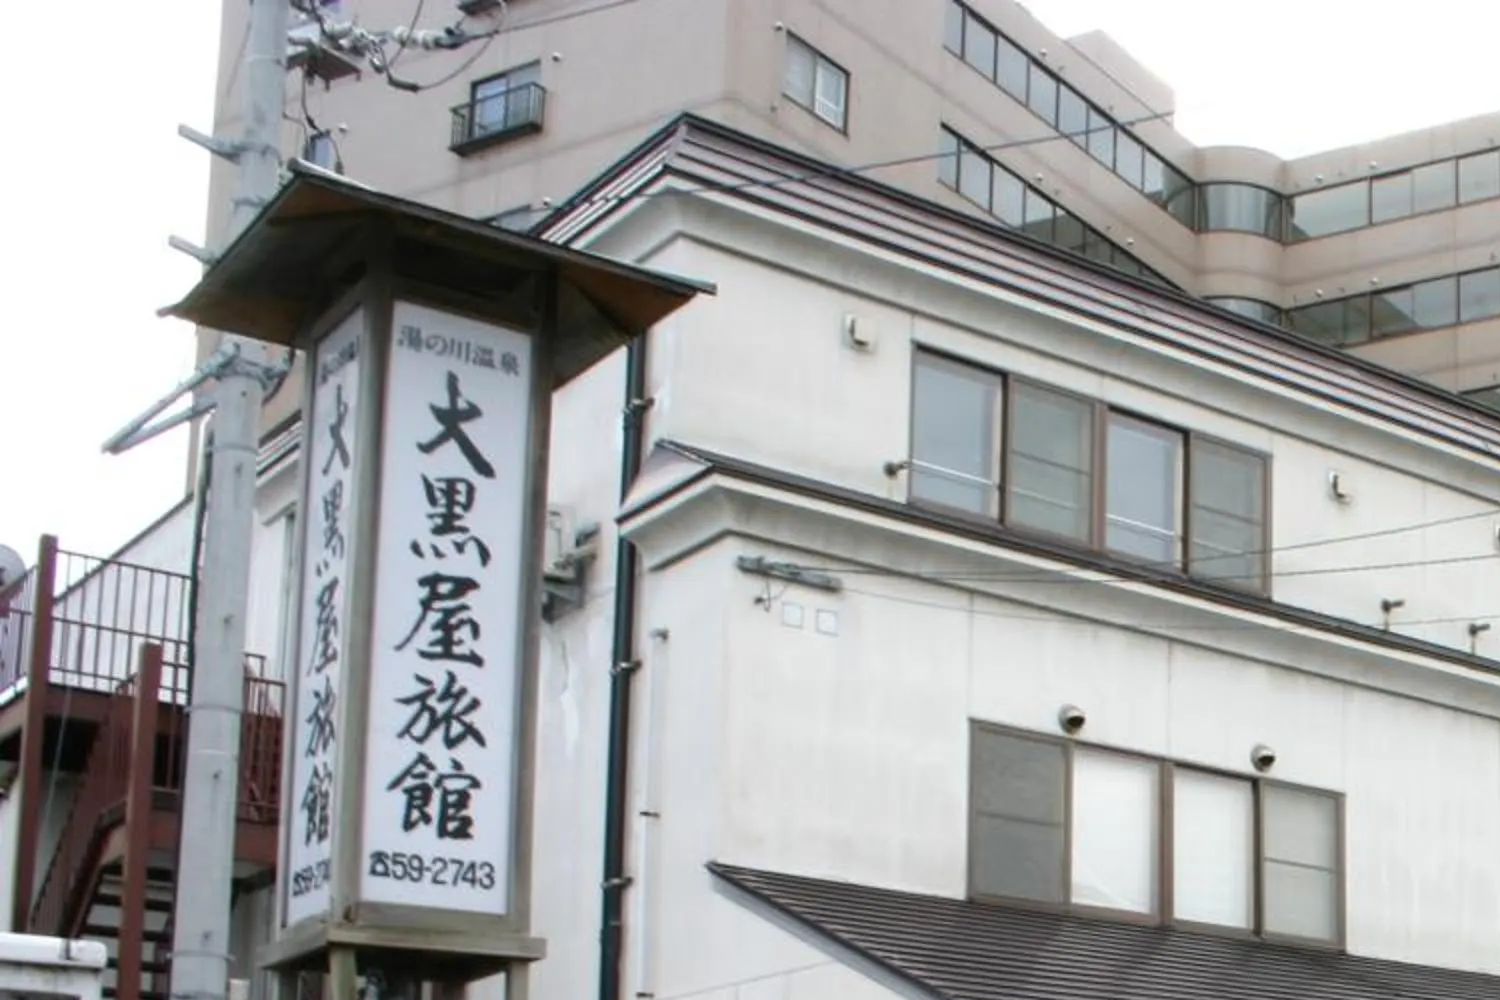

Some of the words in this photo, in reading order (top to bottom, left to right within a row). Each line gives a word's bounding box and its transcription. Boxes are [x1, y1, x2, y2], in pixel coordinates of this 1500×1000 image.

[398, 325, 519, 377] 湯の川温泉
[301, 383, 350, 847] 大黒屋旅館
[386, 370, 496, 841] 大黒屋旅館
[391, 852, 496, 890] 59-2743
